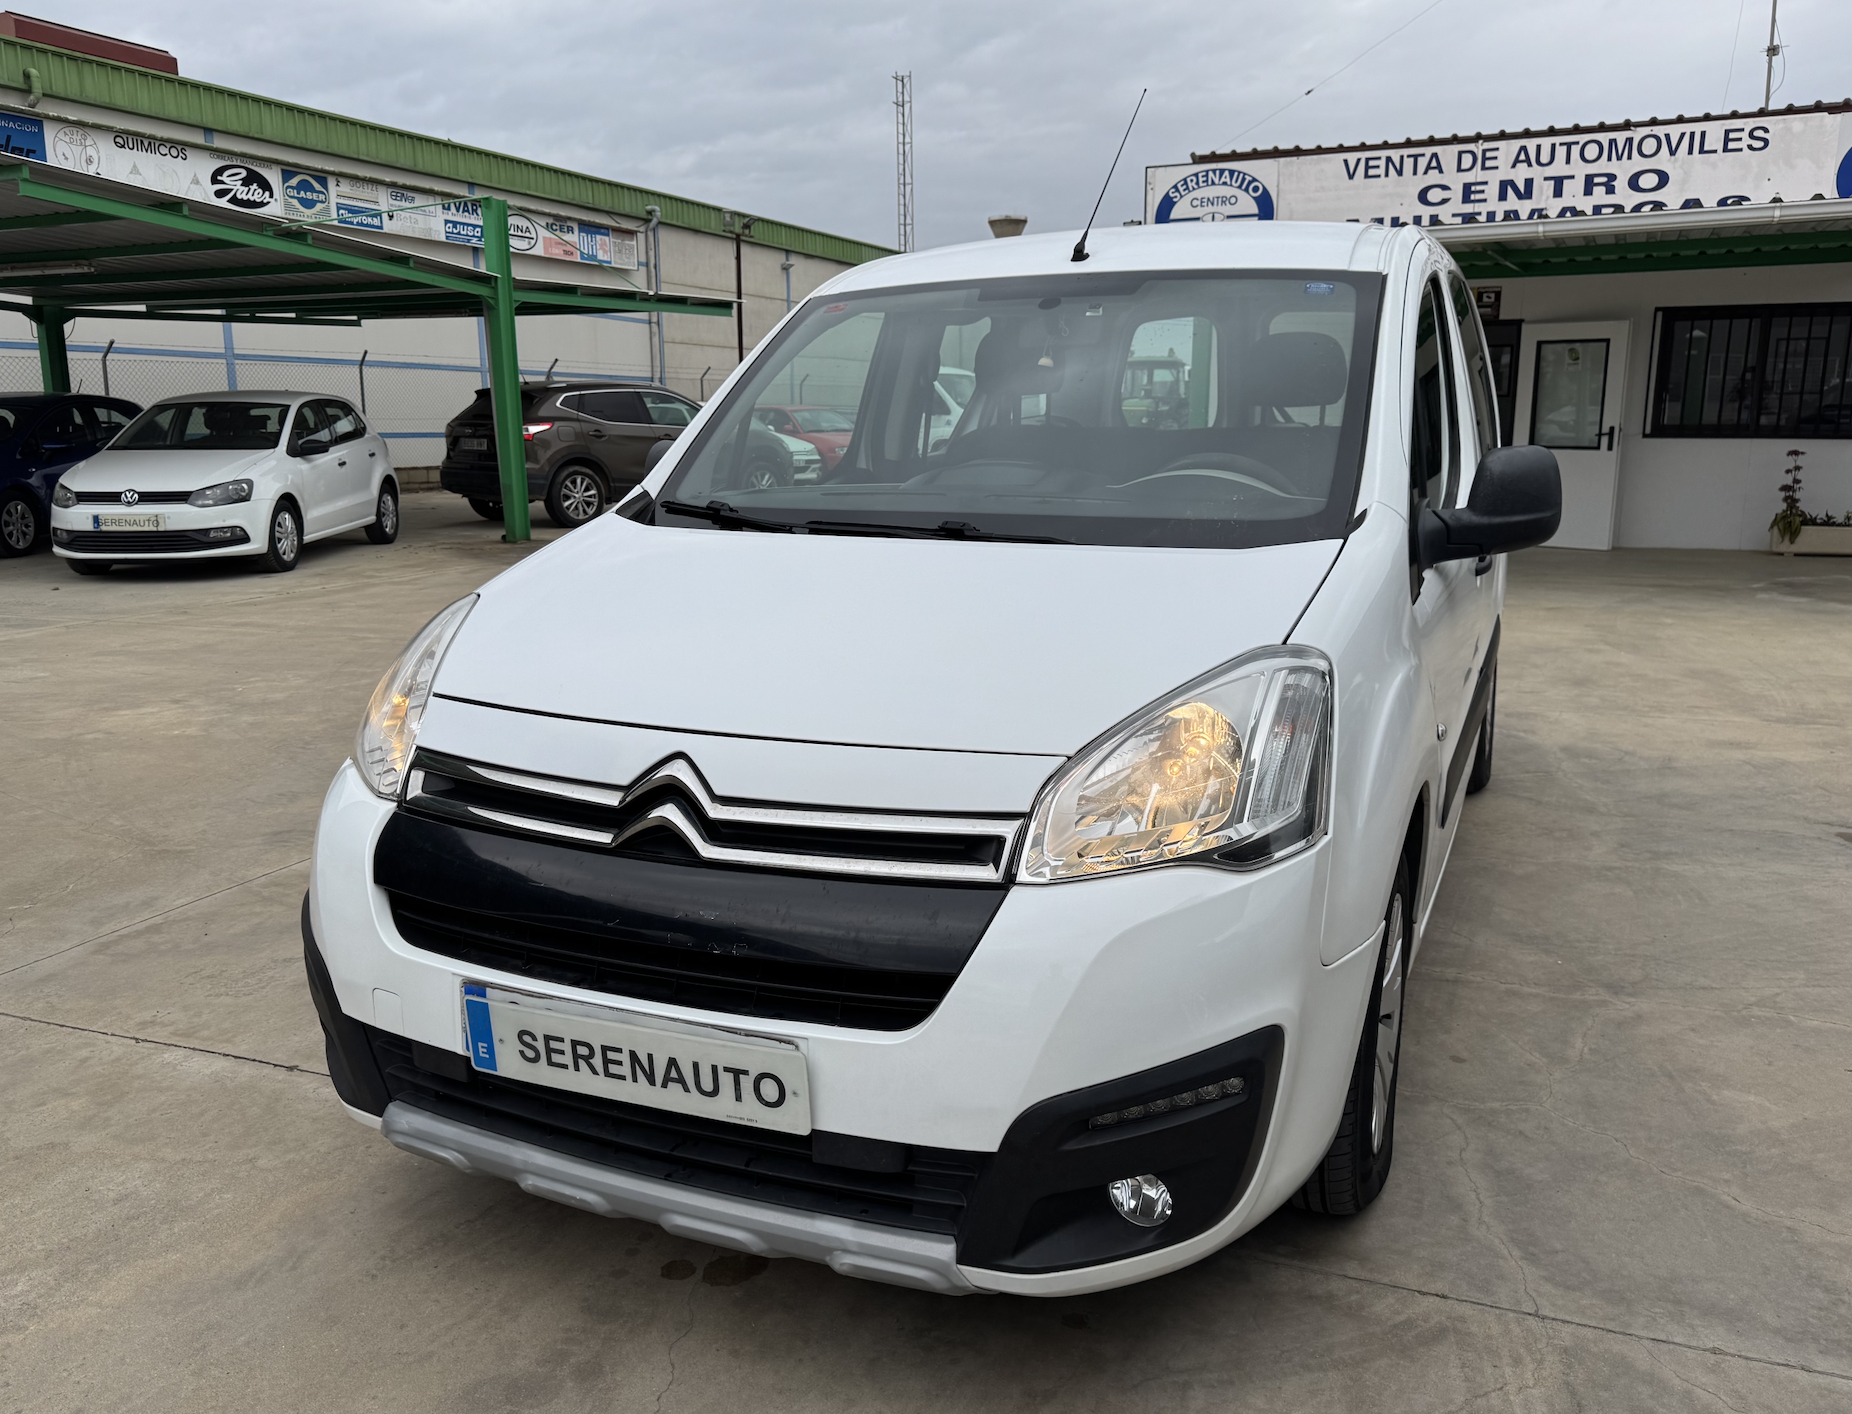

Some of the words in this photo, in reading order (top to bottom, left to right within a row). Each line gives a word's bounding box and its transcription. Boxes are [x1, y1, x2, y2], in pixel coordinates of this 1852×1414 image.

[113, 134, 188, 161] QUIMICOS
[1342, 152, 1445, 181] VENTA
[1456, 147, 1501, 173] DE
[1510, 126, 1771, 170] AUTOMOVILES
[211, 167, 275, 204] Gates
[349, 179, 379, 193] GOETZE
[1168, 169, 1265, 204] SERENAUTO
[1417, 168, 1670, 207] CENTRO
[286, 187, 326, 202] GLASER
[1189, 194, 1239, 209] CENTRO
[453, 200, 482, 216] VAR
[396, 212, 419, 225] Beta
[545, 221, 575, 235] ICER
[98, 518, 160, 528] SERENAUTO
[478, 1041, 490, 1059] E
[516, 1028, 787, 1109] SERENAUTO
